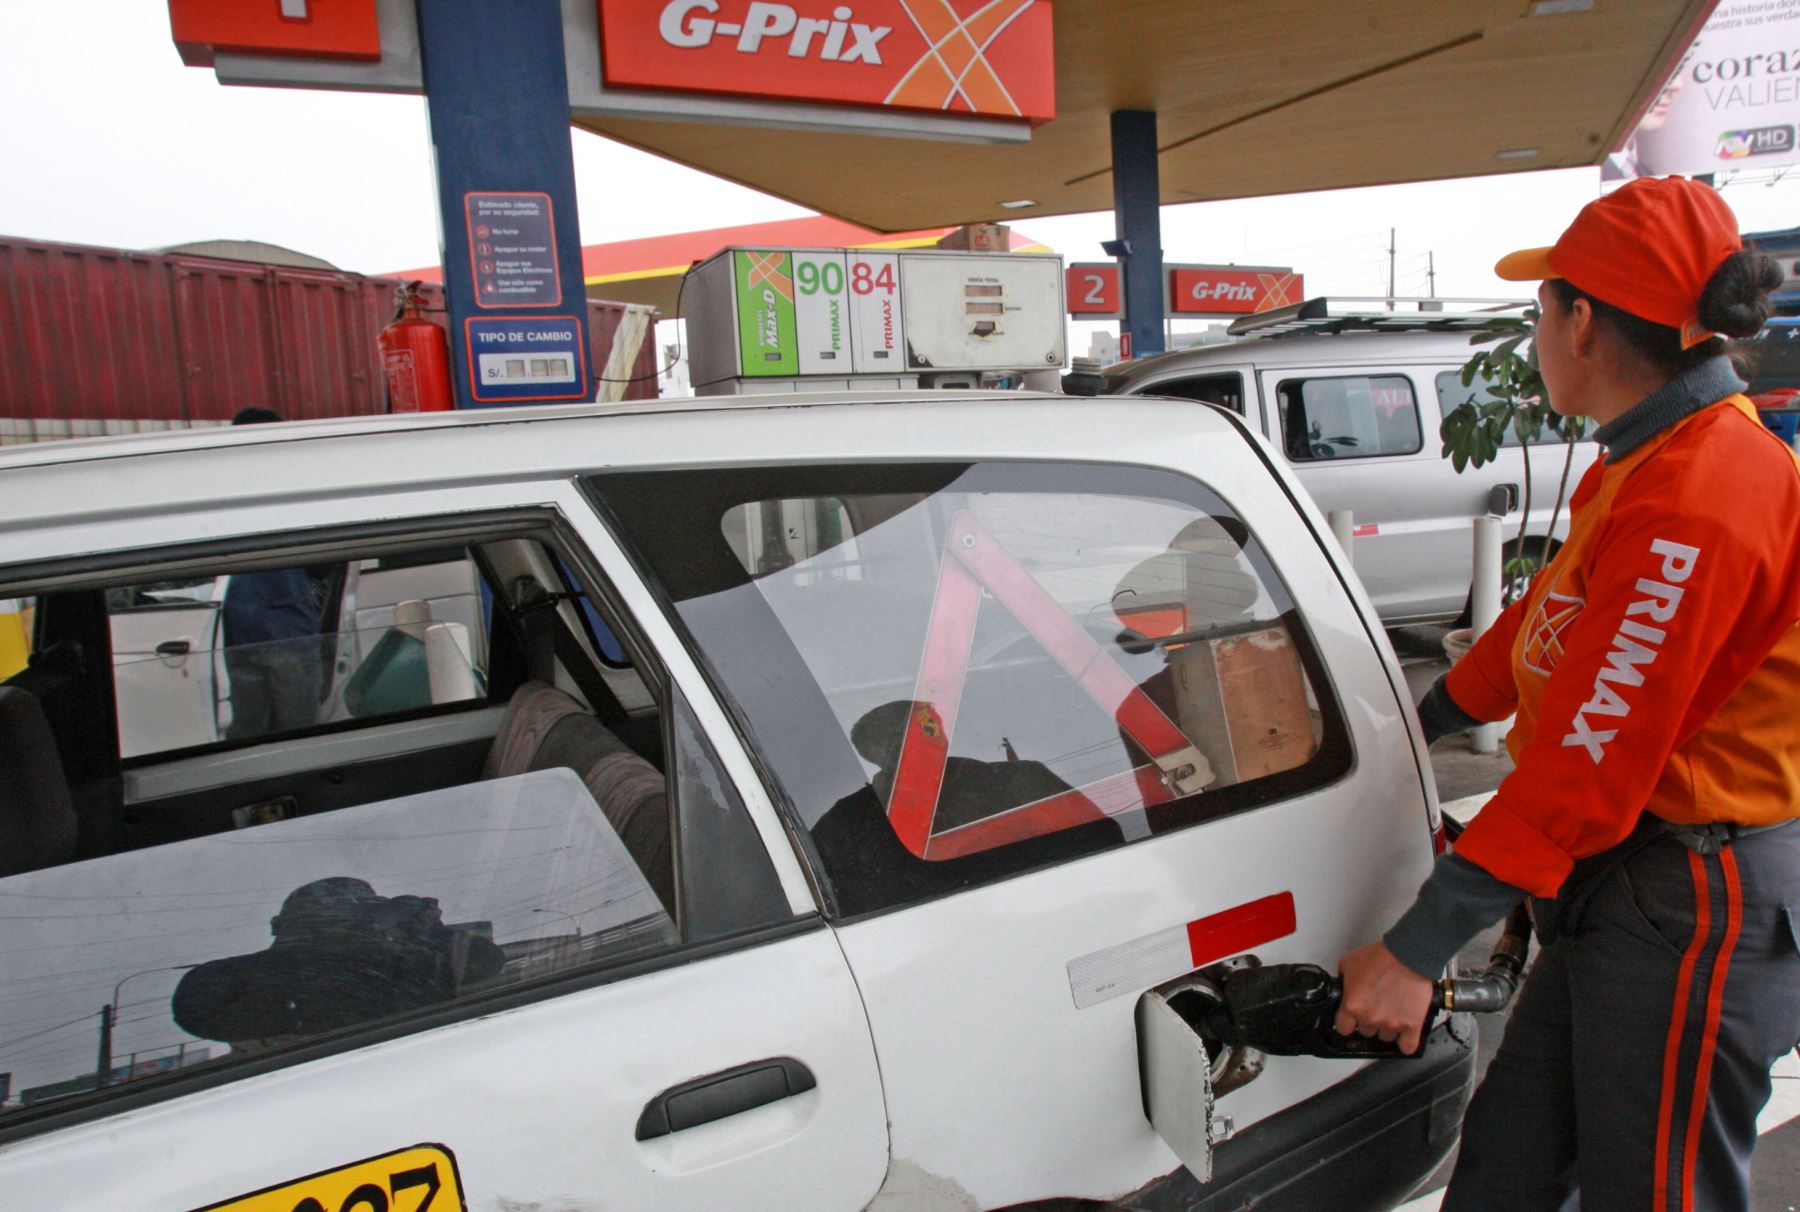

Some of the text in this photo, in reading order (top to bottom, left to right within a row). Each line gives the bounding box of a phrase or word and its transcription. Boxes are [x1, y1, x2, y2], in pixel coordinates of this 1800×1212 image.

[1703, 19, 1741, 31] uestra
[1731, 2, 1774, 17] historia
[659, 0, 892, 65] G-Prix
[1757, 130, 1787, 147] HD
[797, 261, 844, 295] 90
[851, 262, 896, 295] 84
[1083, 274, 1105, 304] 2
[1192, 281, 1257, 301] G-Prix
[762, 288, 778, 349] Max-D
[830, 300, 841, 350] PRIMAX
[883, 299, 894, 349] PRIMAX
[478, 331, 573, 343] TIPO DE CAMBIO
[1561, 538, 1700, 765] PRIMAX
